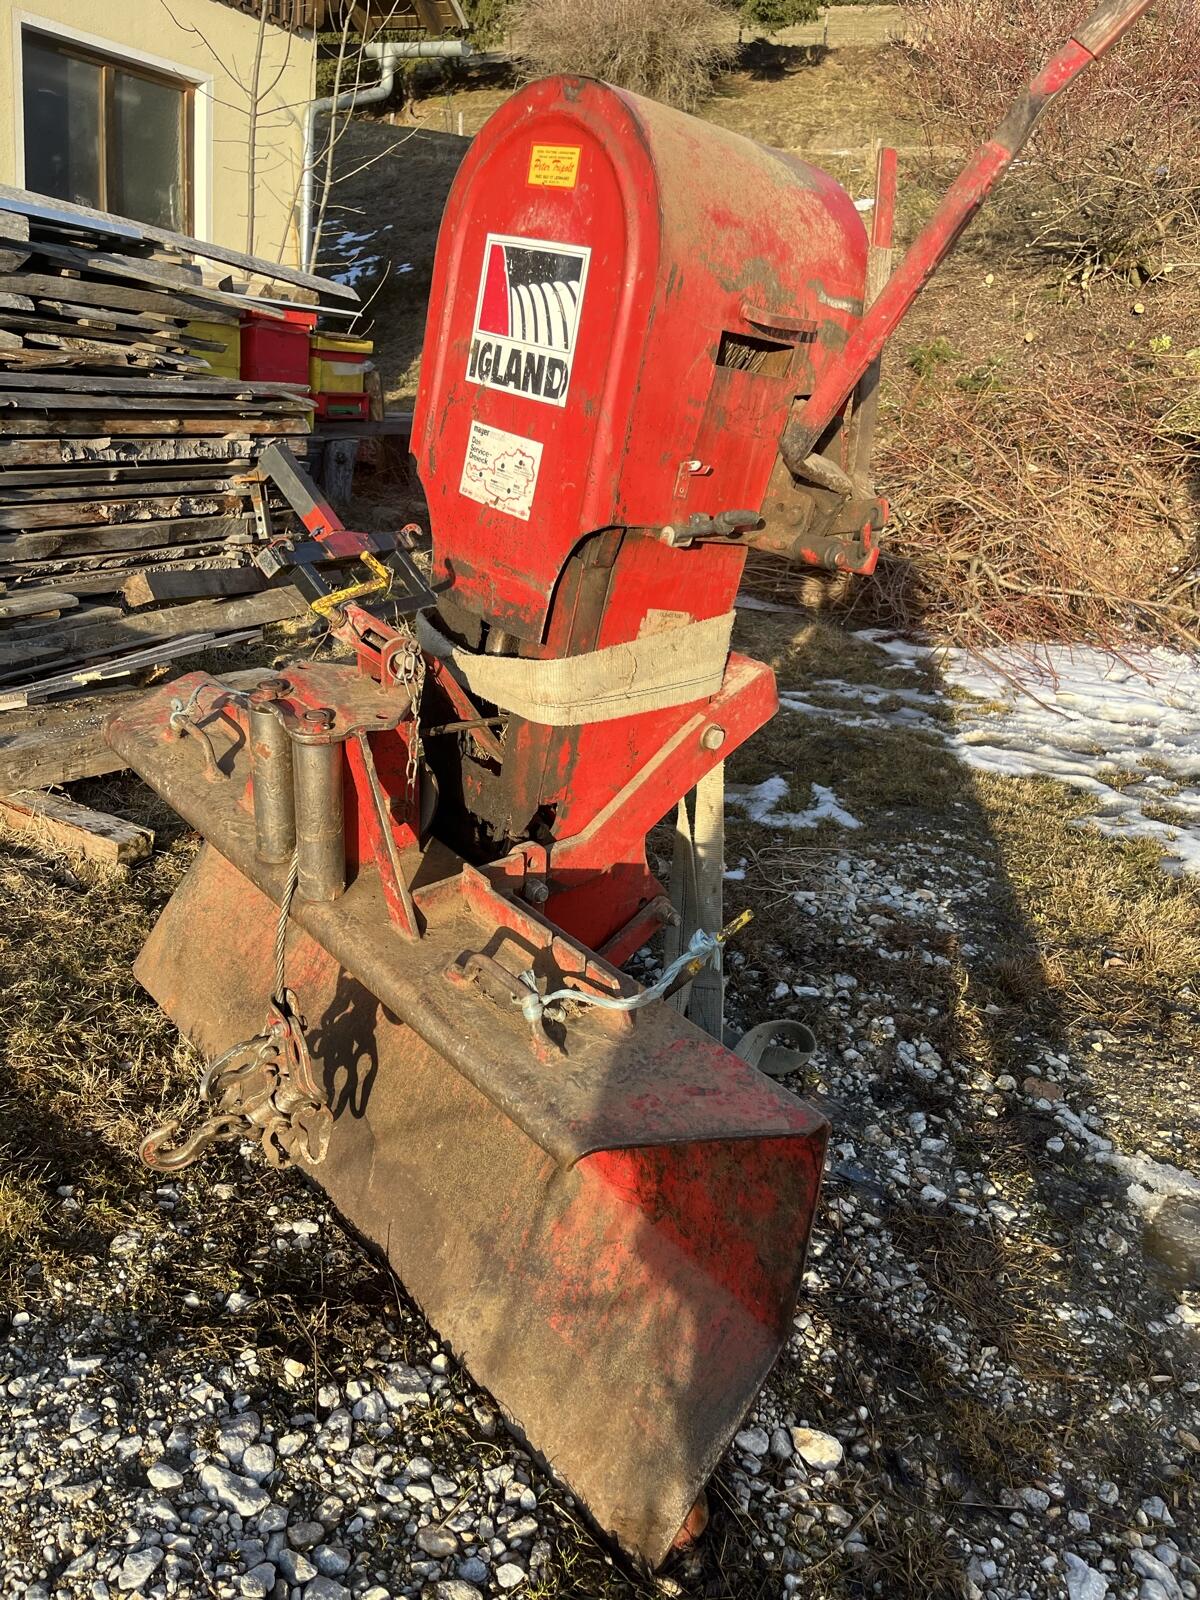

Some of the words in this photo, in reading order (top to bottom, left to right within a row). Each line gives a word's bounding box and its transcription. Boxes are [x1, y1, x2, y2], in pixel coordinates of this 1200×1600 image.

[534, 158, 550, 171] Peter
[468, 338, 569, 400] IGLAND
[473, 425, 490, 437] mayer
